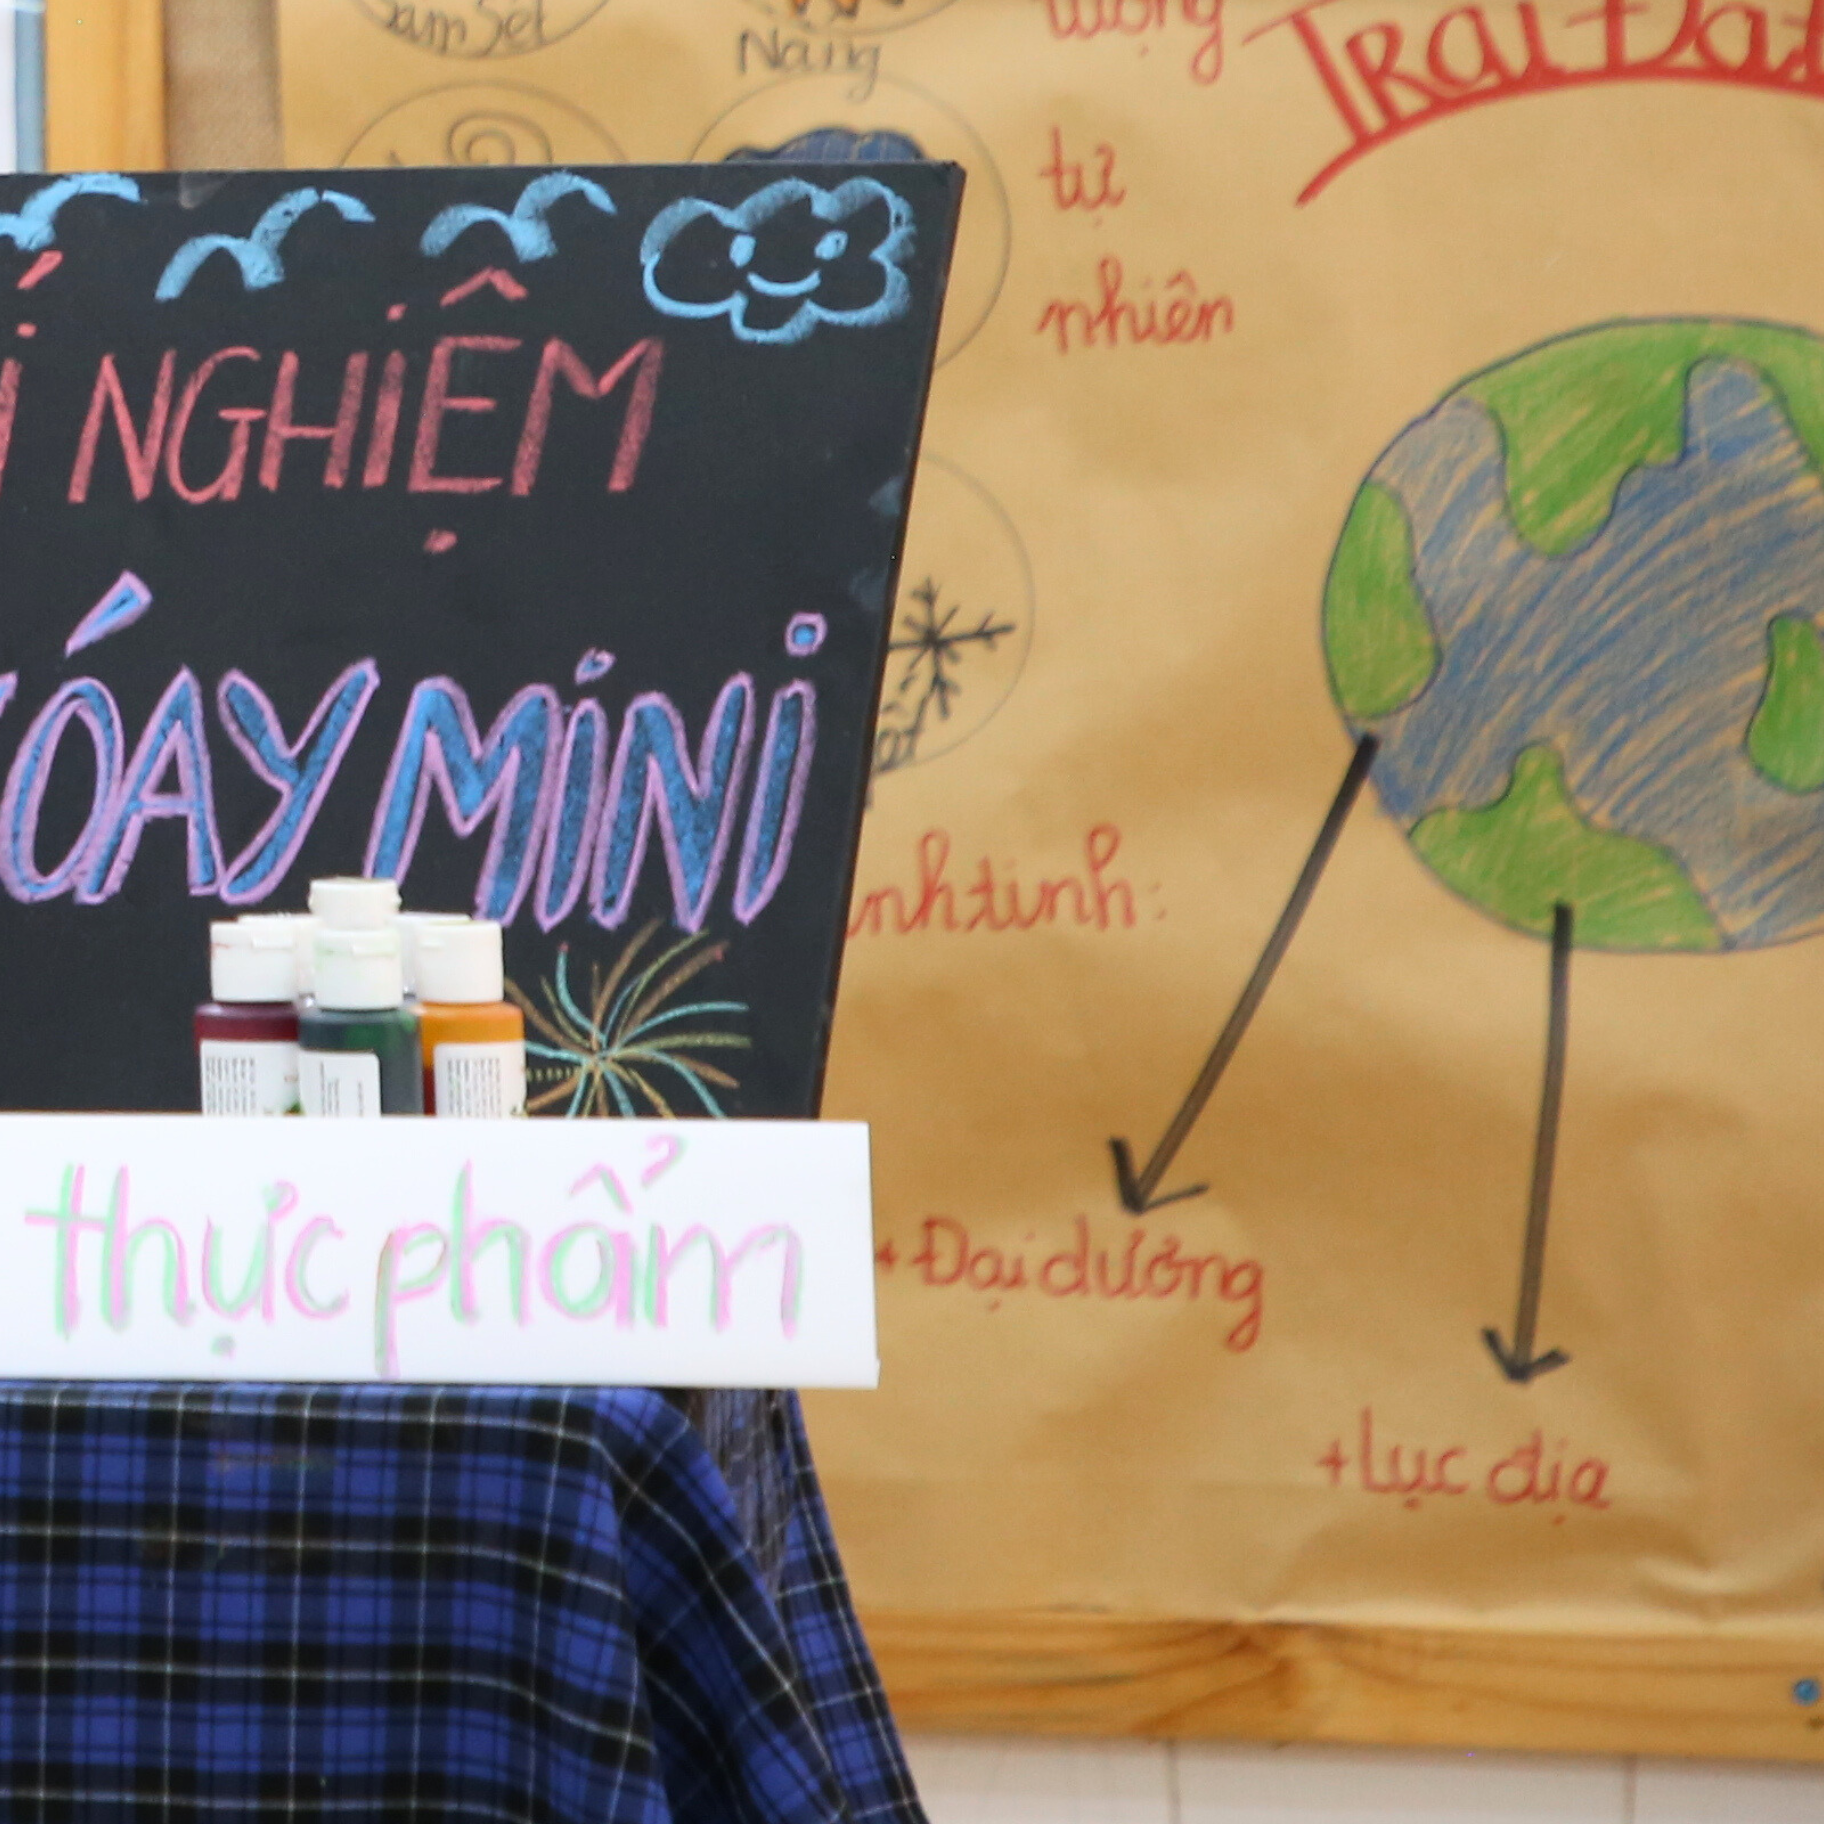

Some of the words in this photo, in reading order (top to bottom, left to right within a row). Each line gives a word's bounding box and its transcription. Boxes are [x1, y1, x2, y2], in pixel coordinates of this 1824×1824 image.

[66, 266, 665, 554] NGHIỆM
[1036, 253, 1235, 357] nhiên
[23, 1156, 354, 1358] thực
[372, 1132, 803, 1377] phẩm
